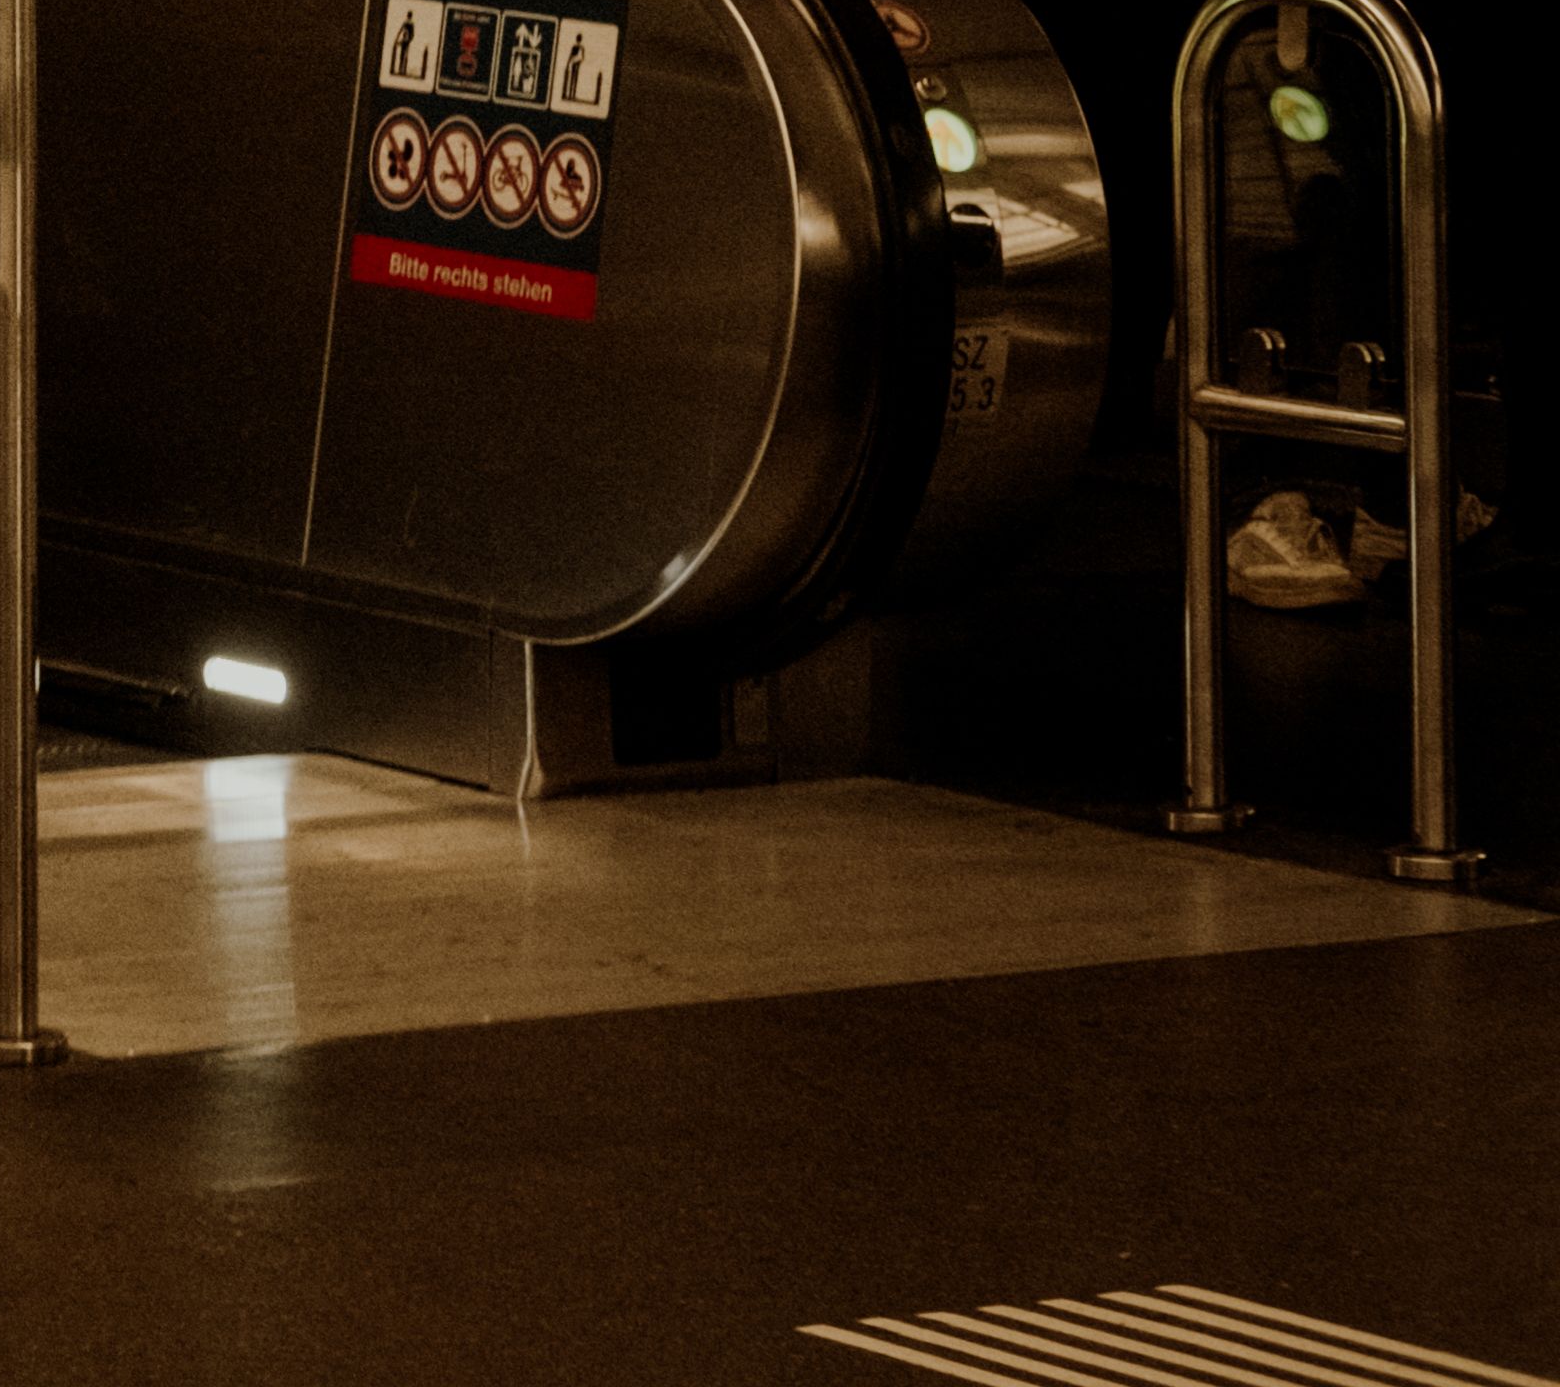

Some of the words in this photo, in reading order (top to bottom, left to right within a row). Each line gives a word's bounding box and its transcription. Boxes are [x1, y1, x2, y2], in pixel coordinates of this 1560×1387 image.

[388, 251, 430, 282] Bitte
[433, 264, 489, 292] rechts
[492, 272, 553, 304] stehen
[952, 335, 988, 370] SZ
